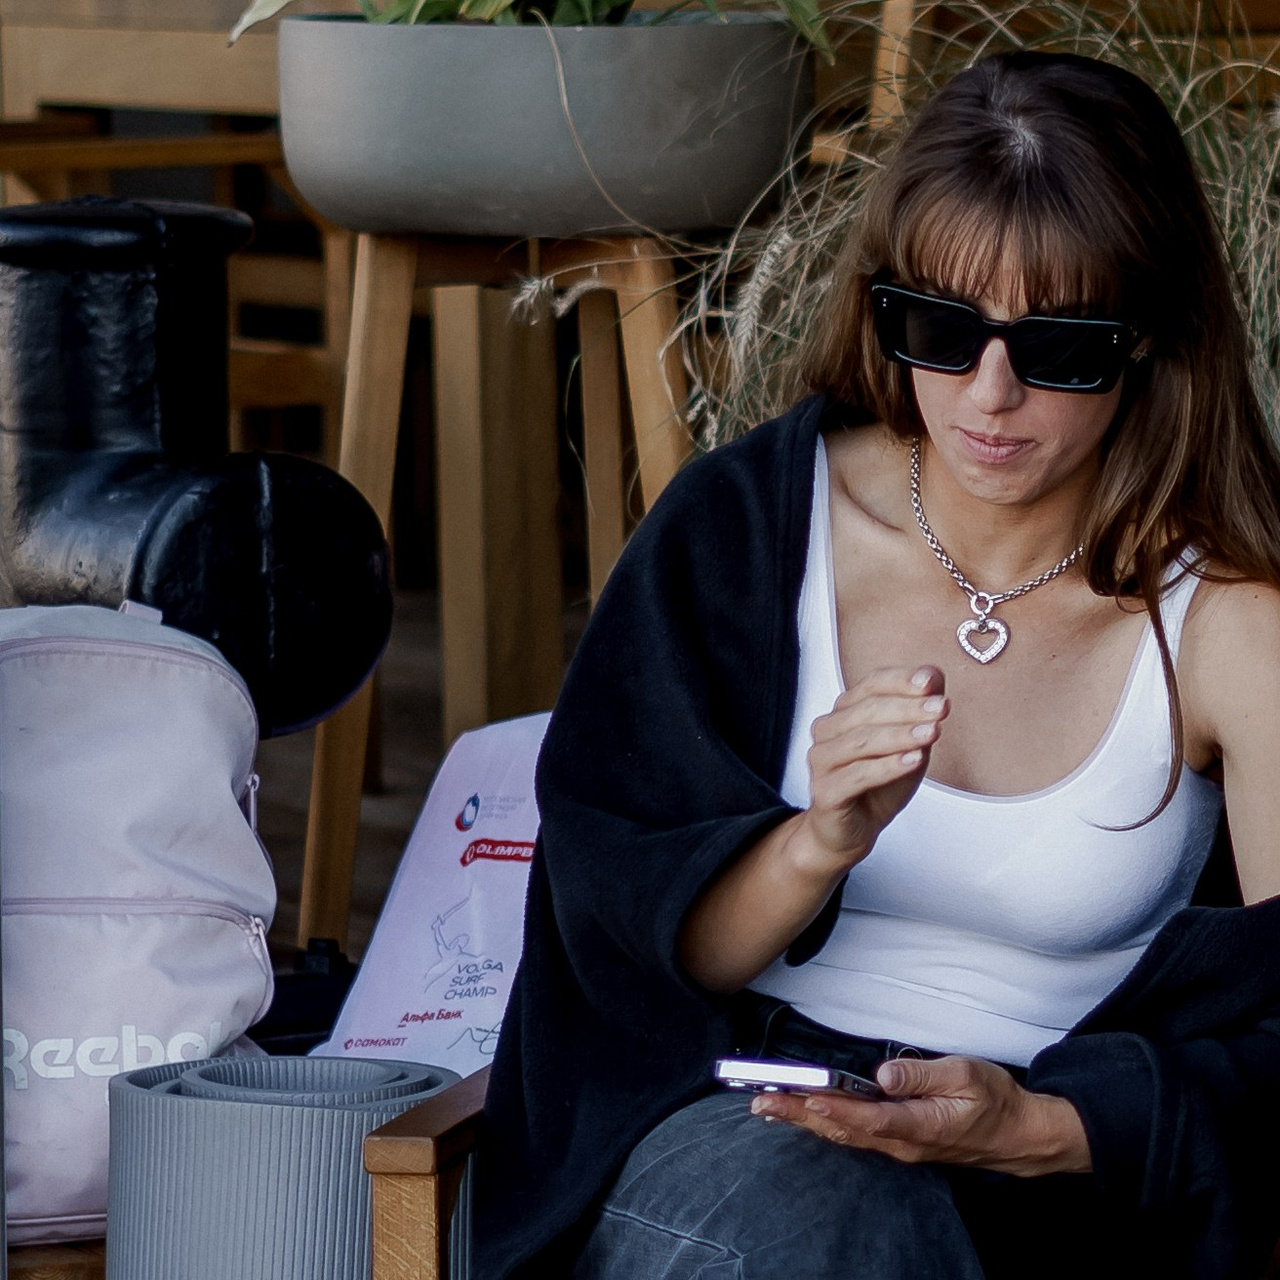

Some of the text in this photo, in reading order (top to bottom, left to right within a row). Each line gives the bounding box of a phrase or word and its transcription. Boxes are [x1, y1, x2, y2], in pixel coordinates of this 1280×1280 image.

[457, 959, 504, 974] VOGA
[450, 972, 487, 988] SURF
[444, 986, 498, 1001] CHAMP
